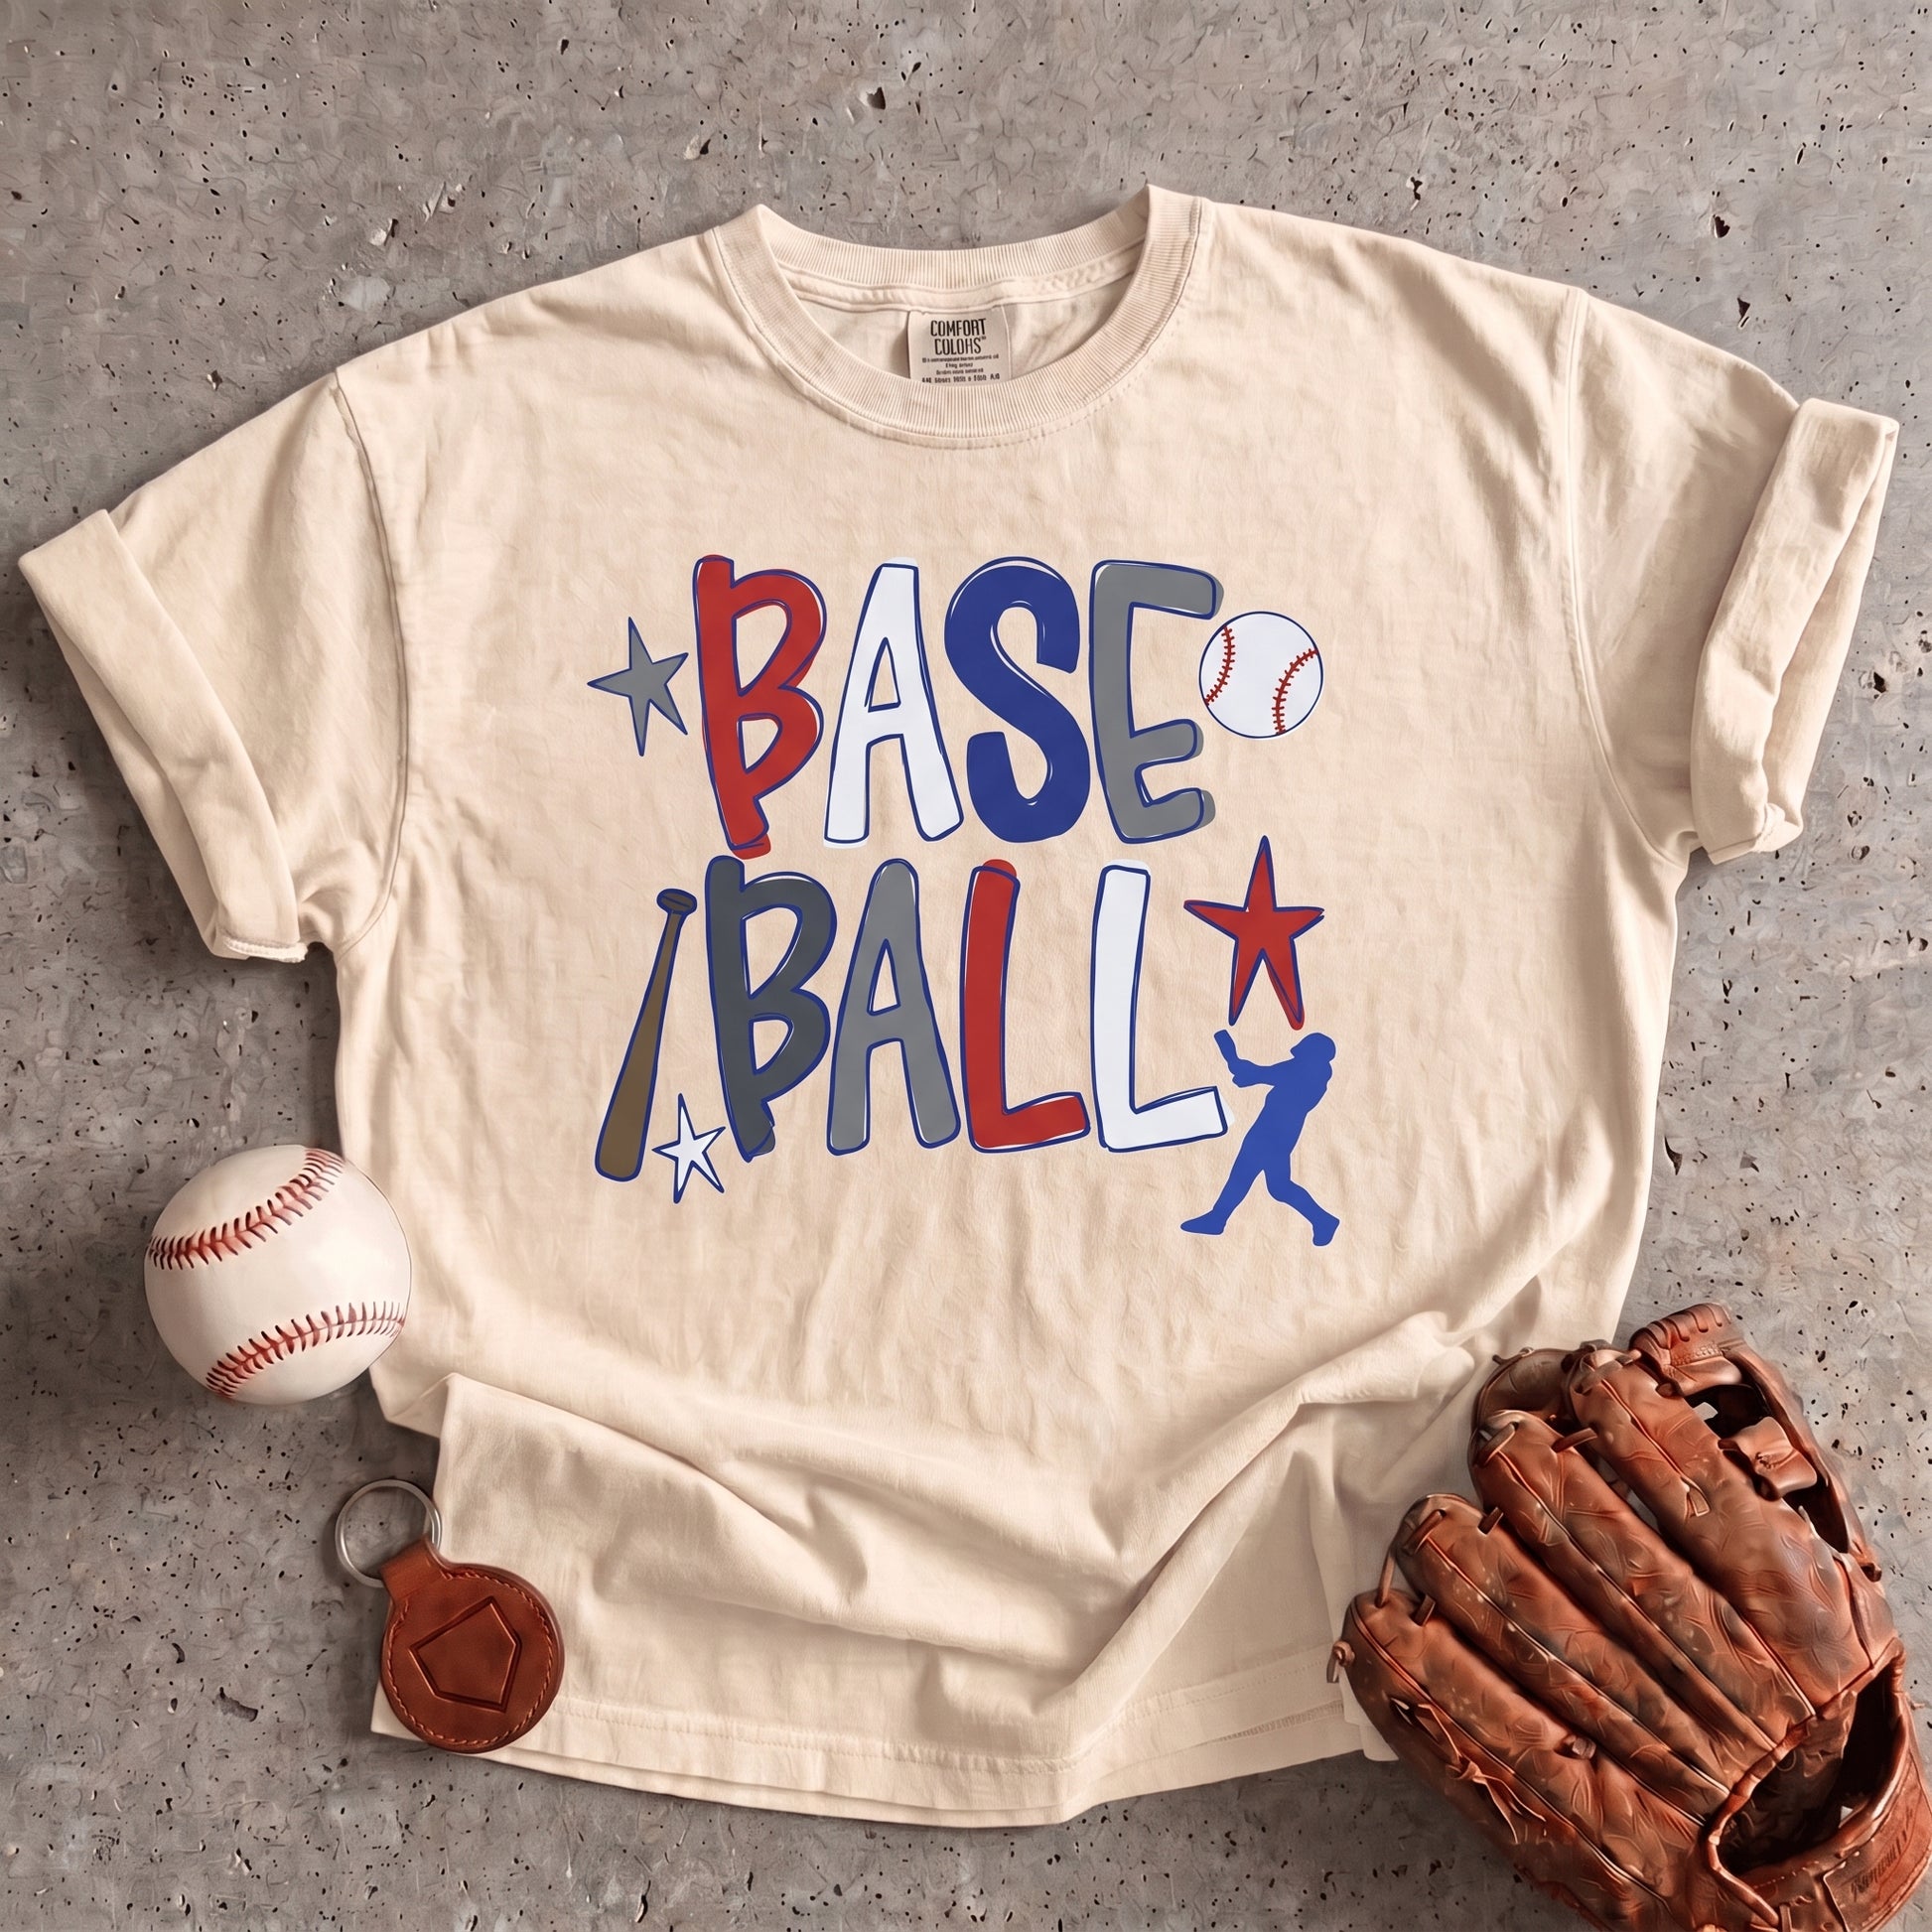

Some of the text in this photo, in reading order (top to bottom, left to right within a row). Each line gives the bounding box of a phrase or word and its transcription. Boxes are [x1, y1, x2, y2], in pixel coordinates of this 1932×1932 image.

[930, 318, 987, 338] COMFORT
[692, 554, 1224, 860] BASE
[705, 855, 1235, 1162] BALL
